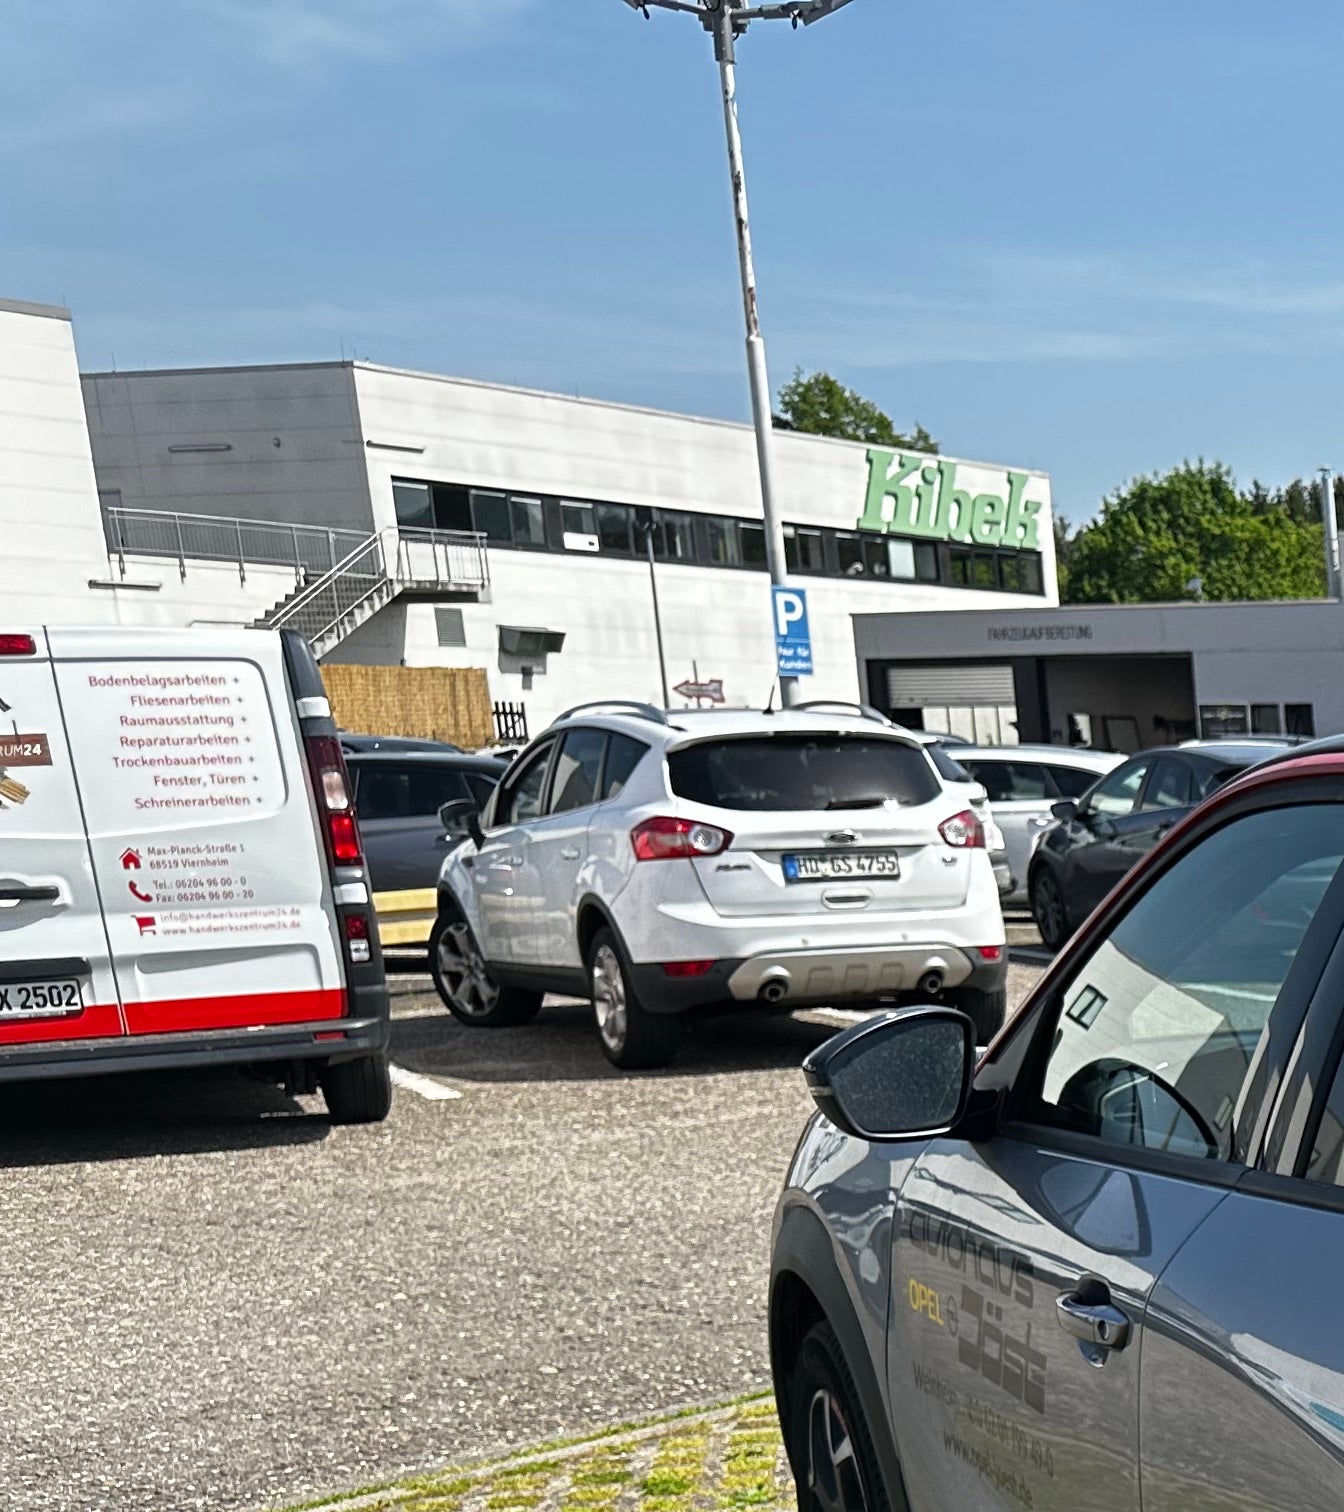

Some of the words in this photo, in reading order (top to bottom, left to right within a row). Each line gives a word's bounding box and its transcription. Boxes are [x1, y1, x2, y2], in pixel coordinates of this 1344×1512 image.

[857, 449, 1042, 549] Kibek
[775, 591, 804, 636] P
[88, 674, 226, 689] Bodenbelagsarbeiten
[130, 694, 231, 707] Fliesenarbeiten
[119, 714, 235, 728] Raumausstattung
[119, 733, 239, 750] Reparaturarbeiten
[112, 755, 242, 769] Trockenbauarbeiten
[153, 774, 208, 788] Fenster,
[208, 773, 246, 786] Türen
[134, 795, 251, 810] Schreinerarbeiten
[181, 857, 229, 869] Viernheim
[797, 857, 820, 874] HD
[856, 854, 897, 873] 4755
[17, 984, 79, 1010] 2502
[908, 1278, 945, 1327] OPEL
